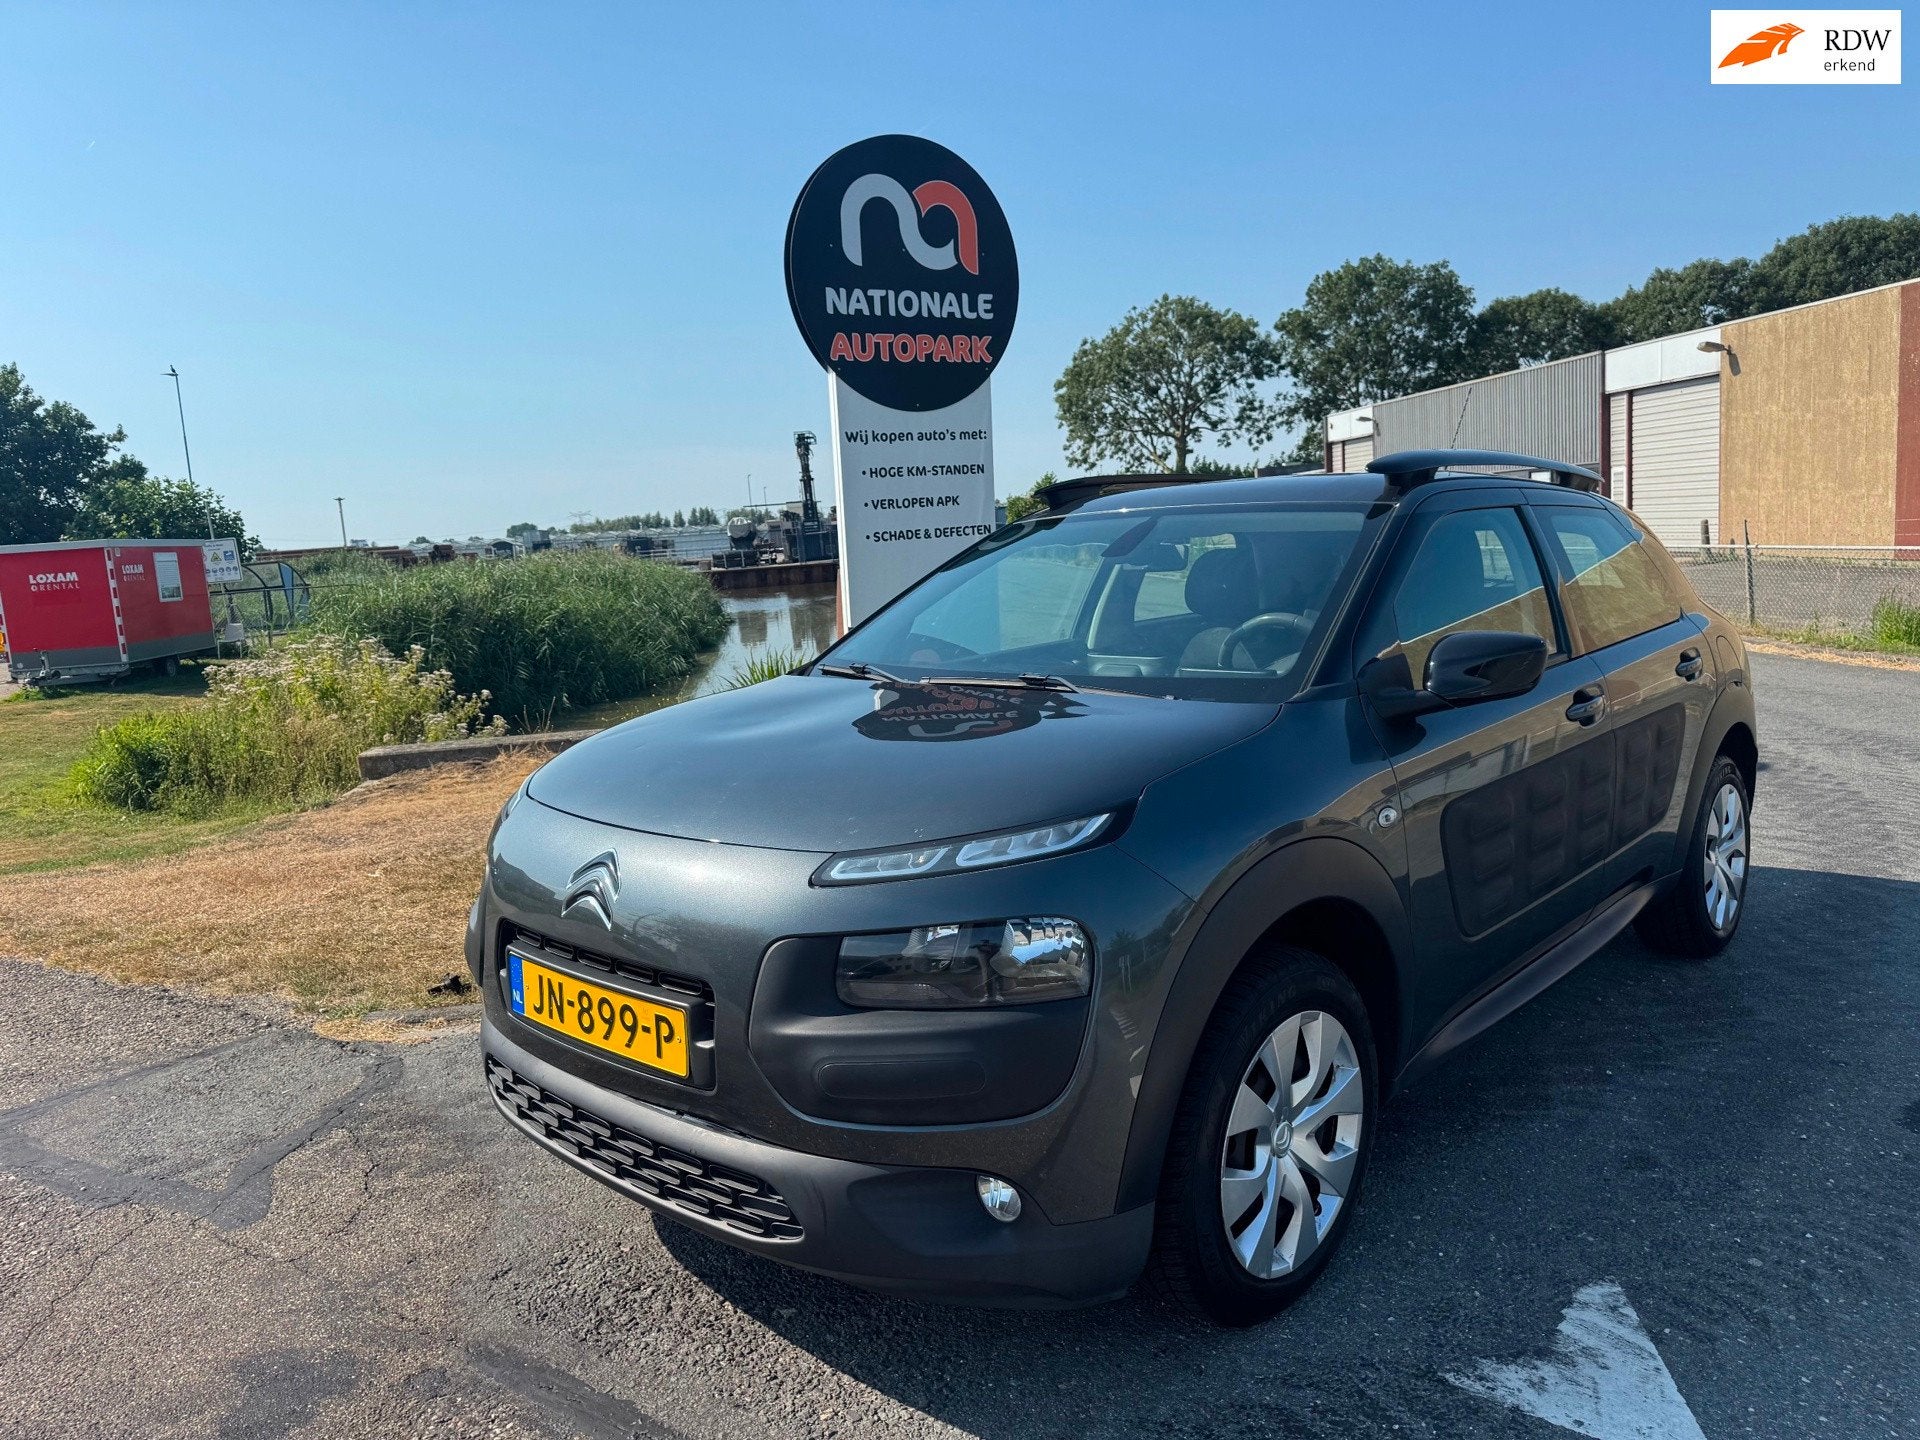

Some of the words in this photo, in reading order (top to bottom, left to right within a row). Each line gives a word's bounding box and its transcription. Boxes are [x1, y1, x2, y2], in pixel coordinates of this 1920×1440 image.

[825, 286, 994, 320] NATIONALE
[830, 332, 993, 363] AUTOPARK
[845, 430, 869, 445] Wij
[872, 430, 914, 444] kopen
[917, 428, 956, 442] auto's
[959, 429, 987, 440] met:
[869, 466, 904, 478] HOGE
[907, 463, 985, 477] KM-STANDEN
[871, 496, 934, 510] VERLOPEN
[936, 495, 960, 507] APK
[873, 529, 921, 542] SCHADE
[924, 529, 932, 539] &
[934, 524, 992, 538] DEFECTEN
[122, 564, 144, 574] LOXAM
[28, 571, 79, 584] LOXAM
[512, 988, 523, 1003] NL
[533, 974, 675, 1060] JN-899-P
